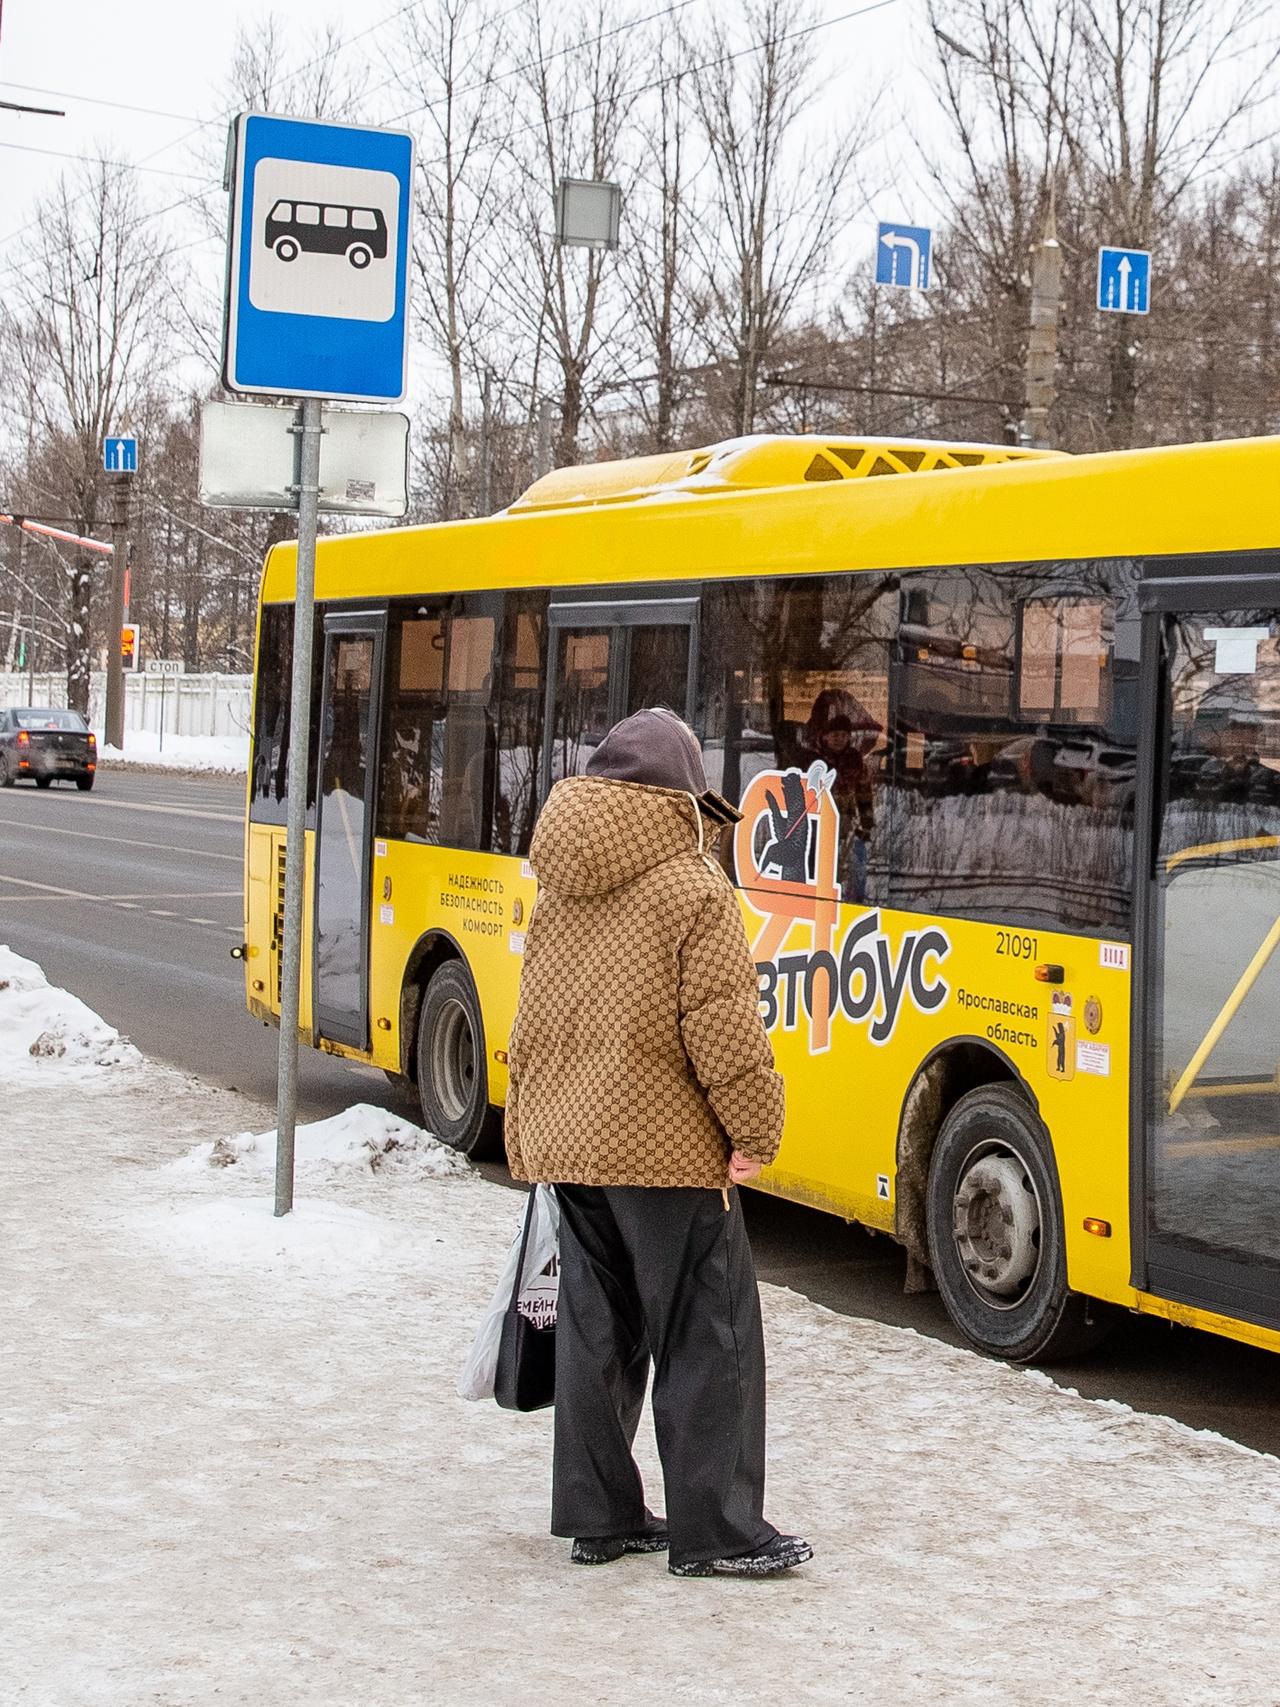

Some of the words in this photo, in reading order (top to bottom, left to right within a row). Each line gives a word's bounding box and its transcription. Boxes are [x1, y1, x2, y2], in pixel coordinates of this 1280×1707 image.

[448, 874, 504, 894] НАДЕЖНОСТЬ
[440, 893, 504, 915] БЕЗОПАСНОСТЬ
[463, 919, 503, 937] КОМФОРТ
[996, 931, 1038, 961] 21091
[755, 913, 949, 1041] втобус
[957, 988, 1038, 1020] Ярославская
[987, 1023, 1038, 1048] область
